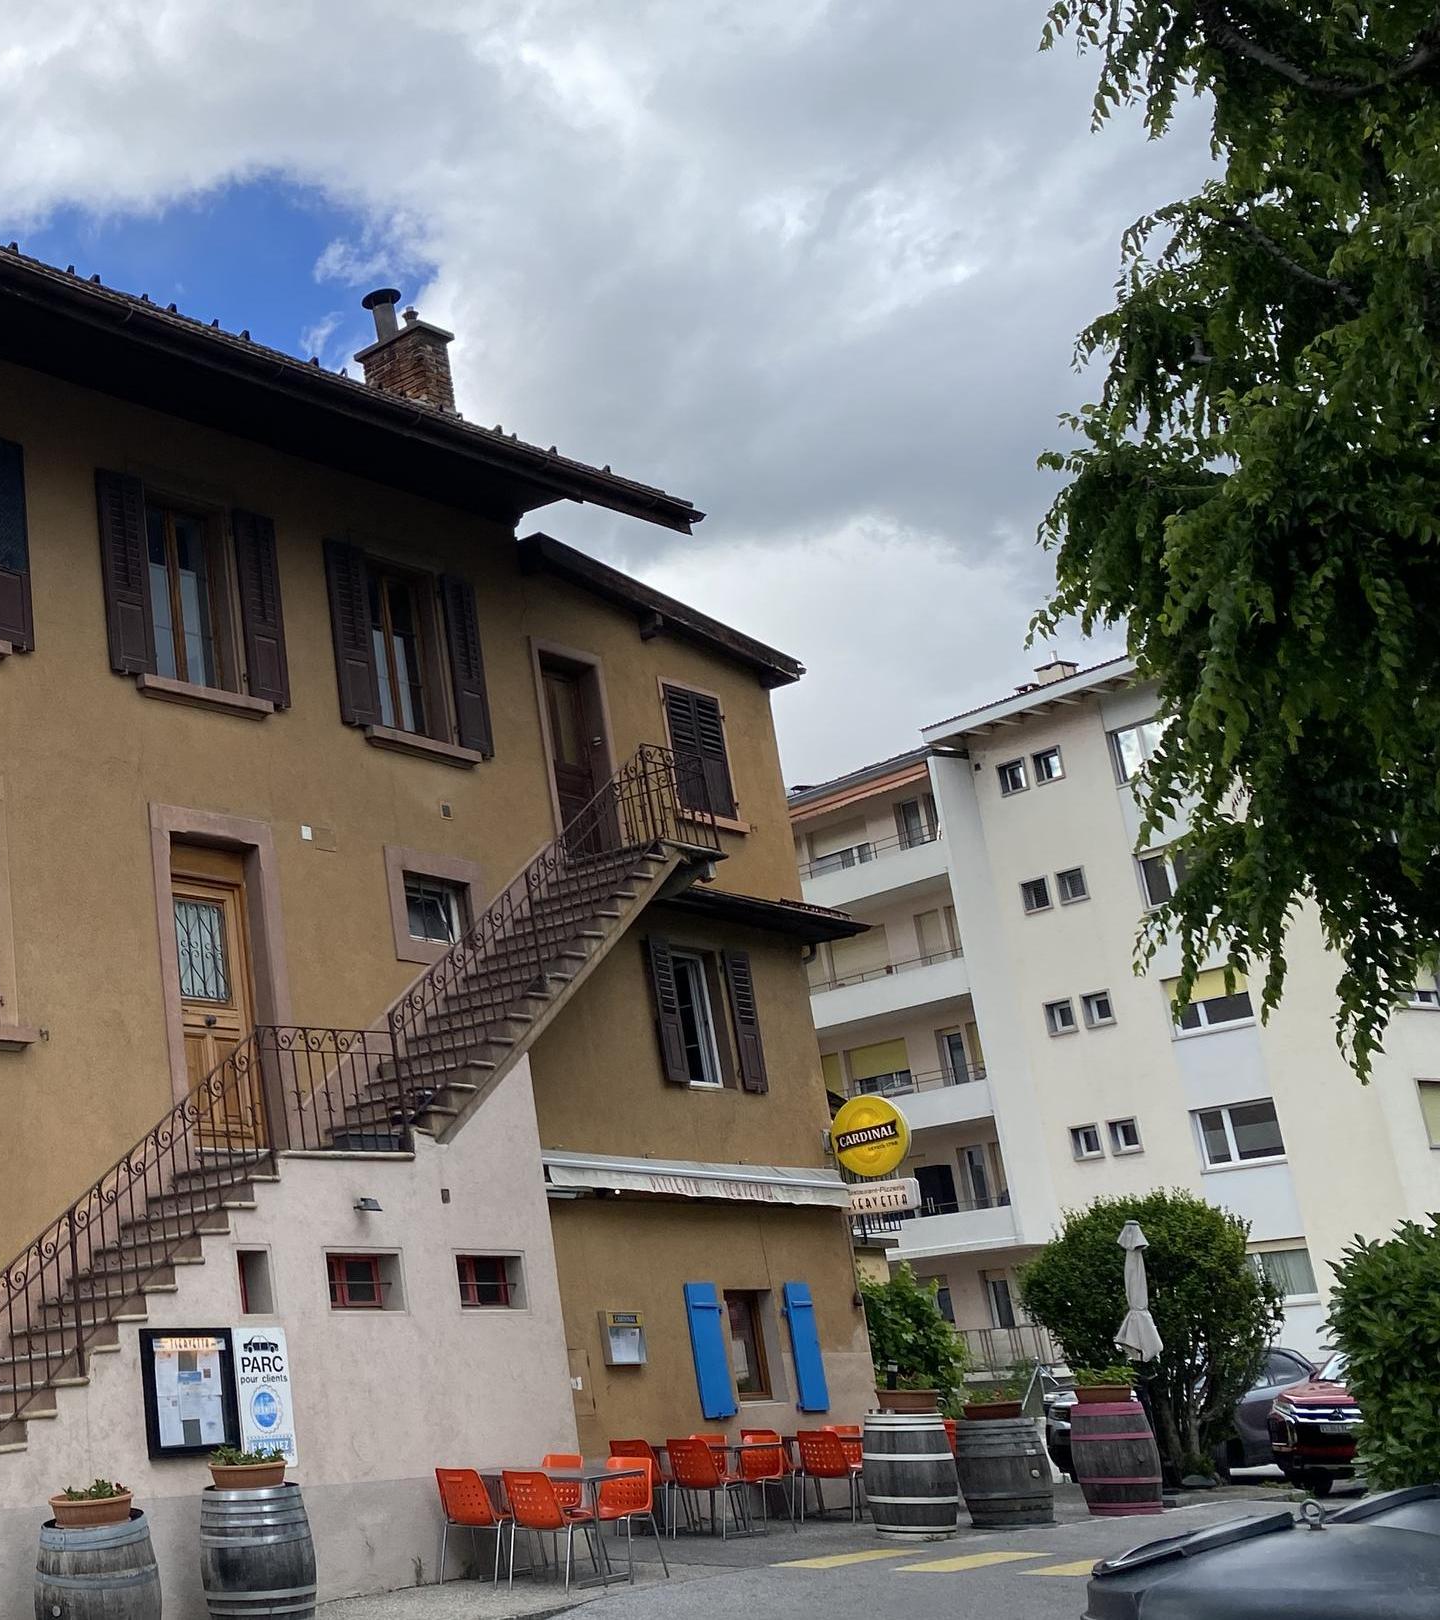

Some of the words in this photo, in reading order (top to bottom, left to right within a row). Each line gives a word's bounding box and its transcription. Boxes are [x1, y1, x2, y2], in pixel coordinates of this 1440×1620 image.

[839, 1124, 896, 1148] CARDINAL
[847, 1193, 908, 1211] SERVETTA
[241, 1355, 284, 1373] PARC
[240, 1376, 258, 1385] pour
[261, 1374, 288, 1383] clients
